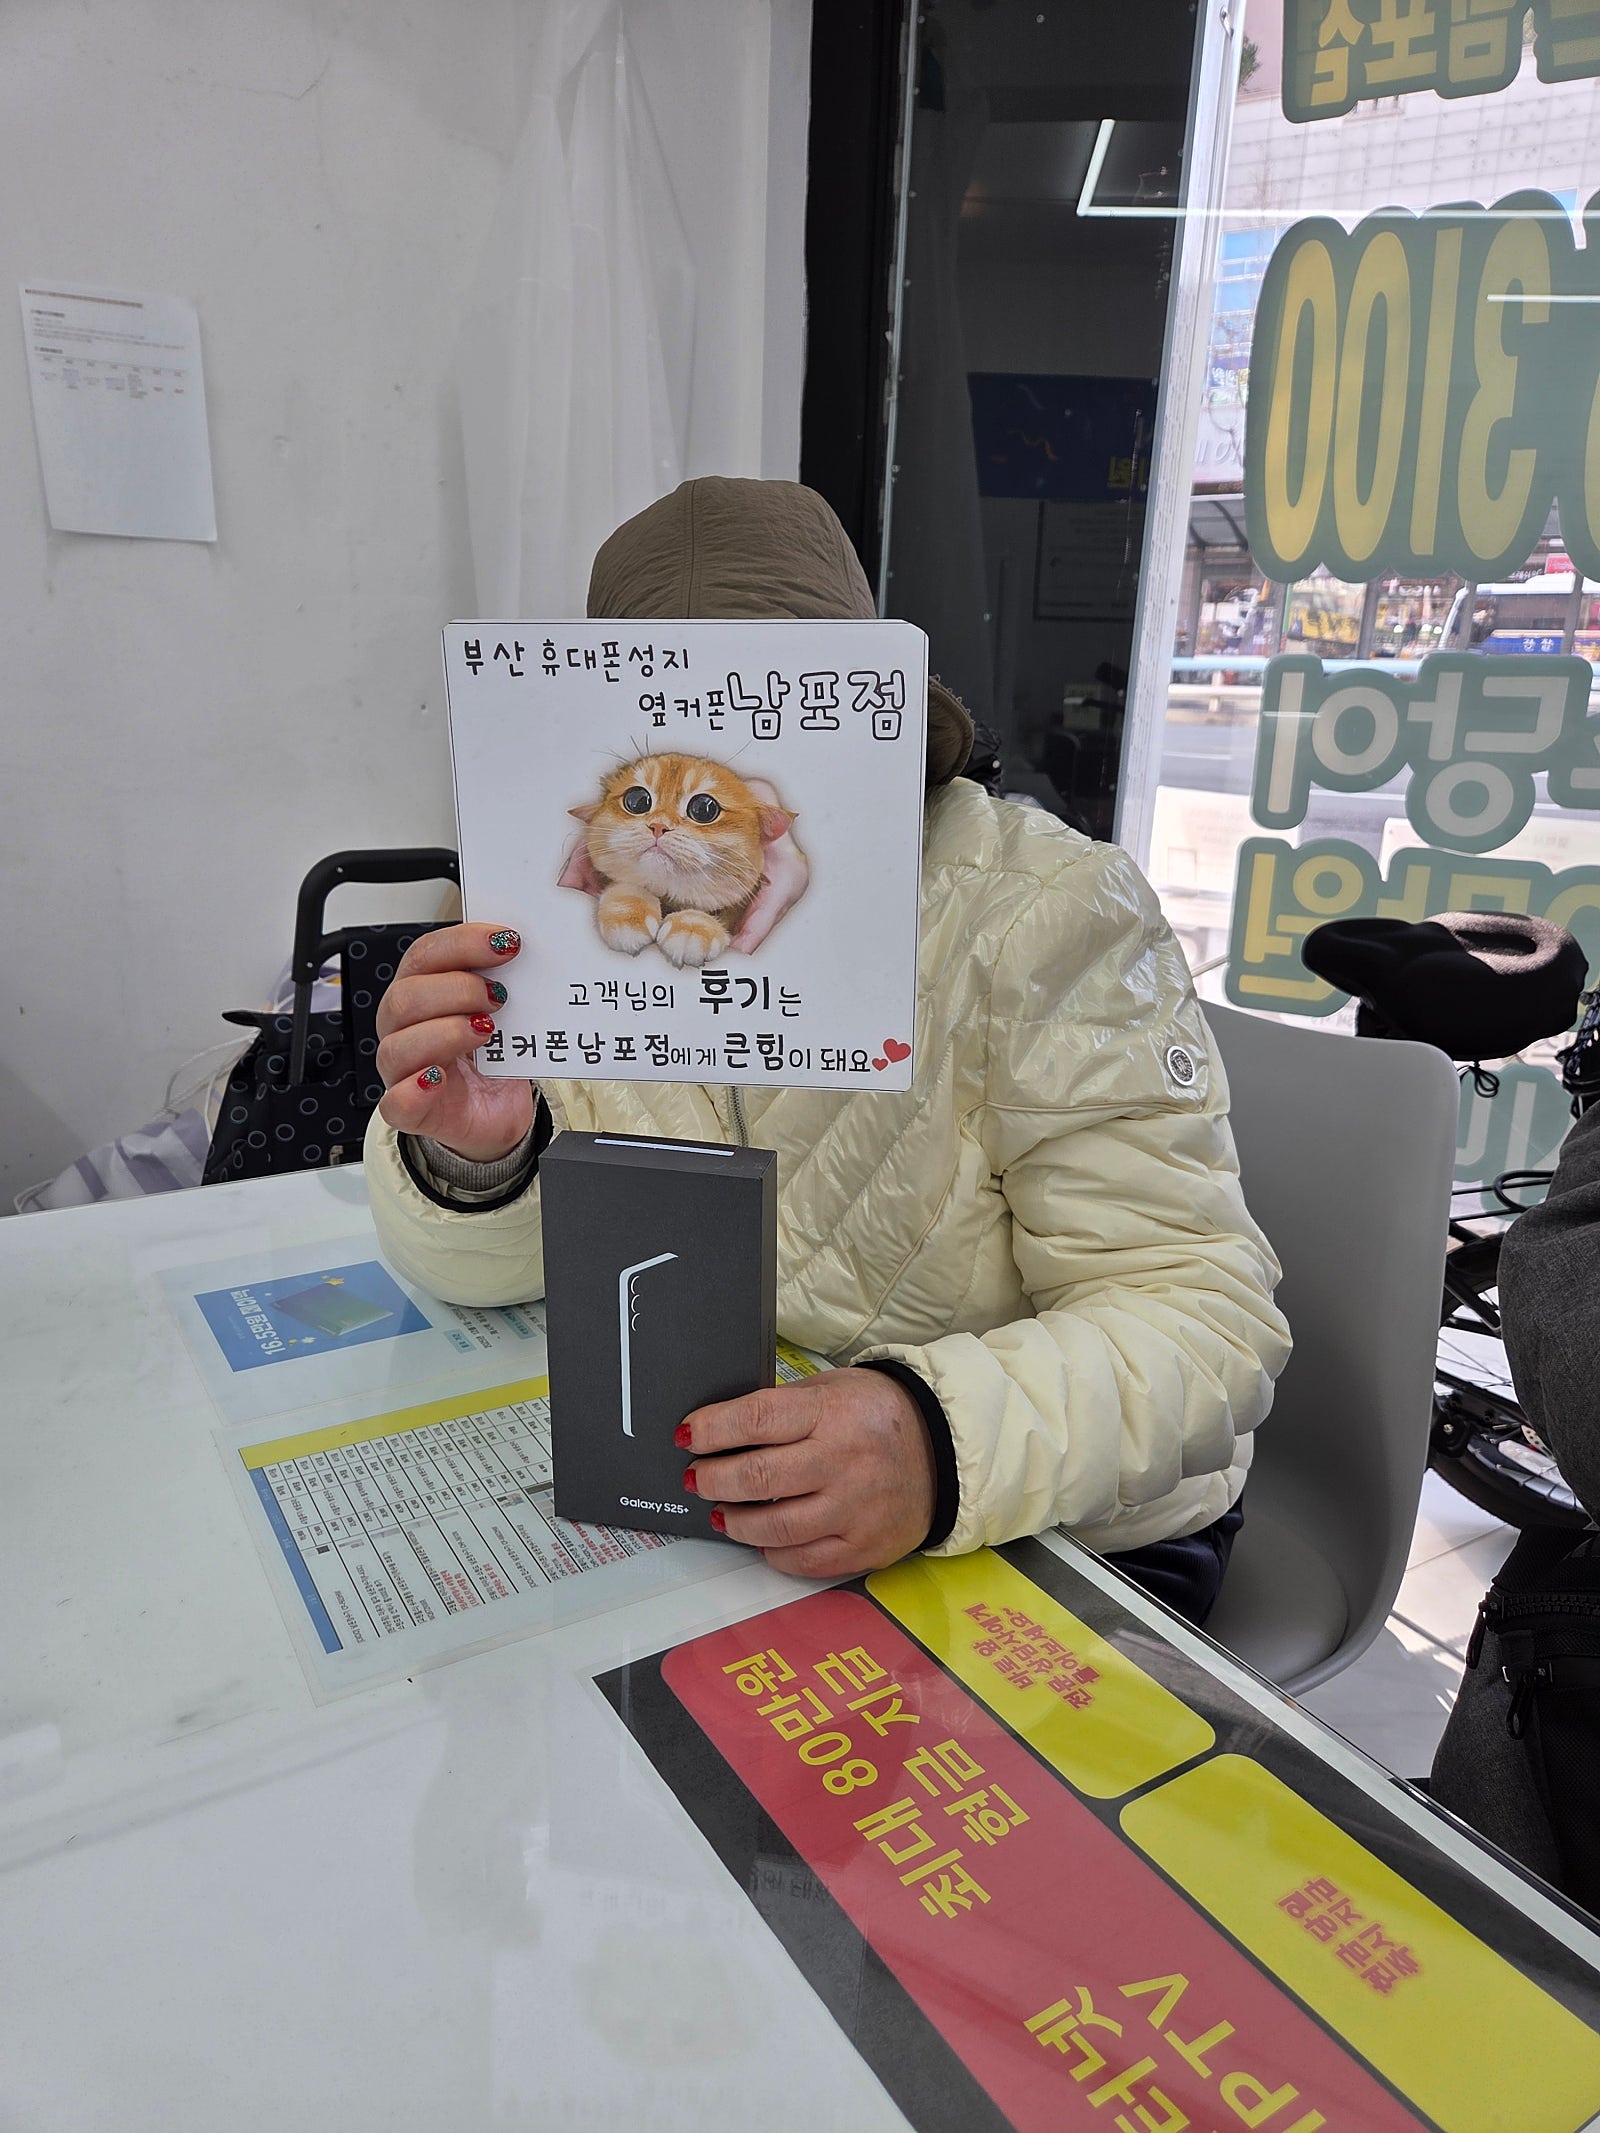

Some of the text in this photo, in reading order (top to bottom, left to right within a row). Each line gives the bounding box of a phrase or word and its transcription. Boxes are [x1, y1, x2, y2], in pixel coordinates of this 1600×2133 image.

[464, 639, 689, 683] 부산 휴대폰성지
[568, 968, 802, 1018] 고객님의 후기는
[820, 1049, 871, 1073] 돼요
[619, 1496, 690, 1514] Galaxy S25+
[964, 1604, 1094, 1709] 전문 상담사에게
[973, 1639, 1034, 1690] 바로 앞
[722, 1647, 878, 1795] 80만원
[813, 1646, 1030, 1845] 현금 지급
[853, 1798, 991, 1918] 최대
[1278, 1890, 1398, 1994] 현금 당일
[1304, 1877, 1418, 1977] 즉시 지급
